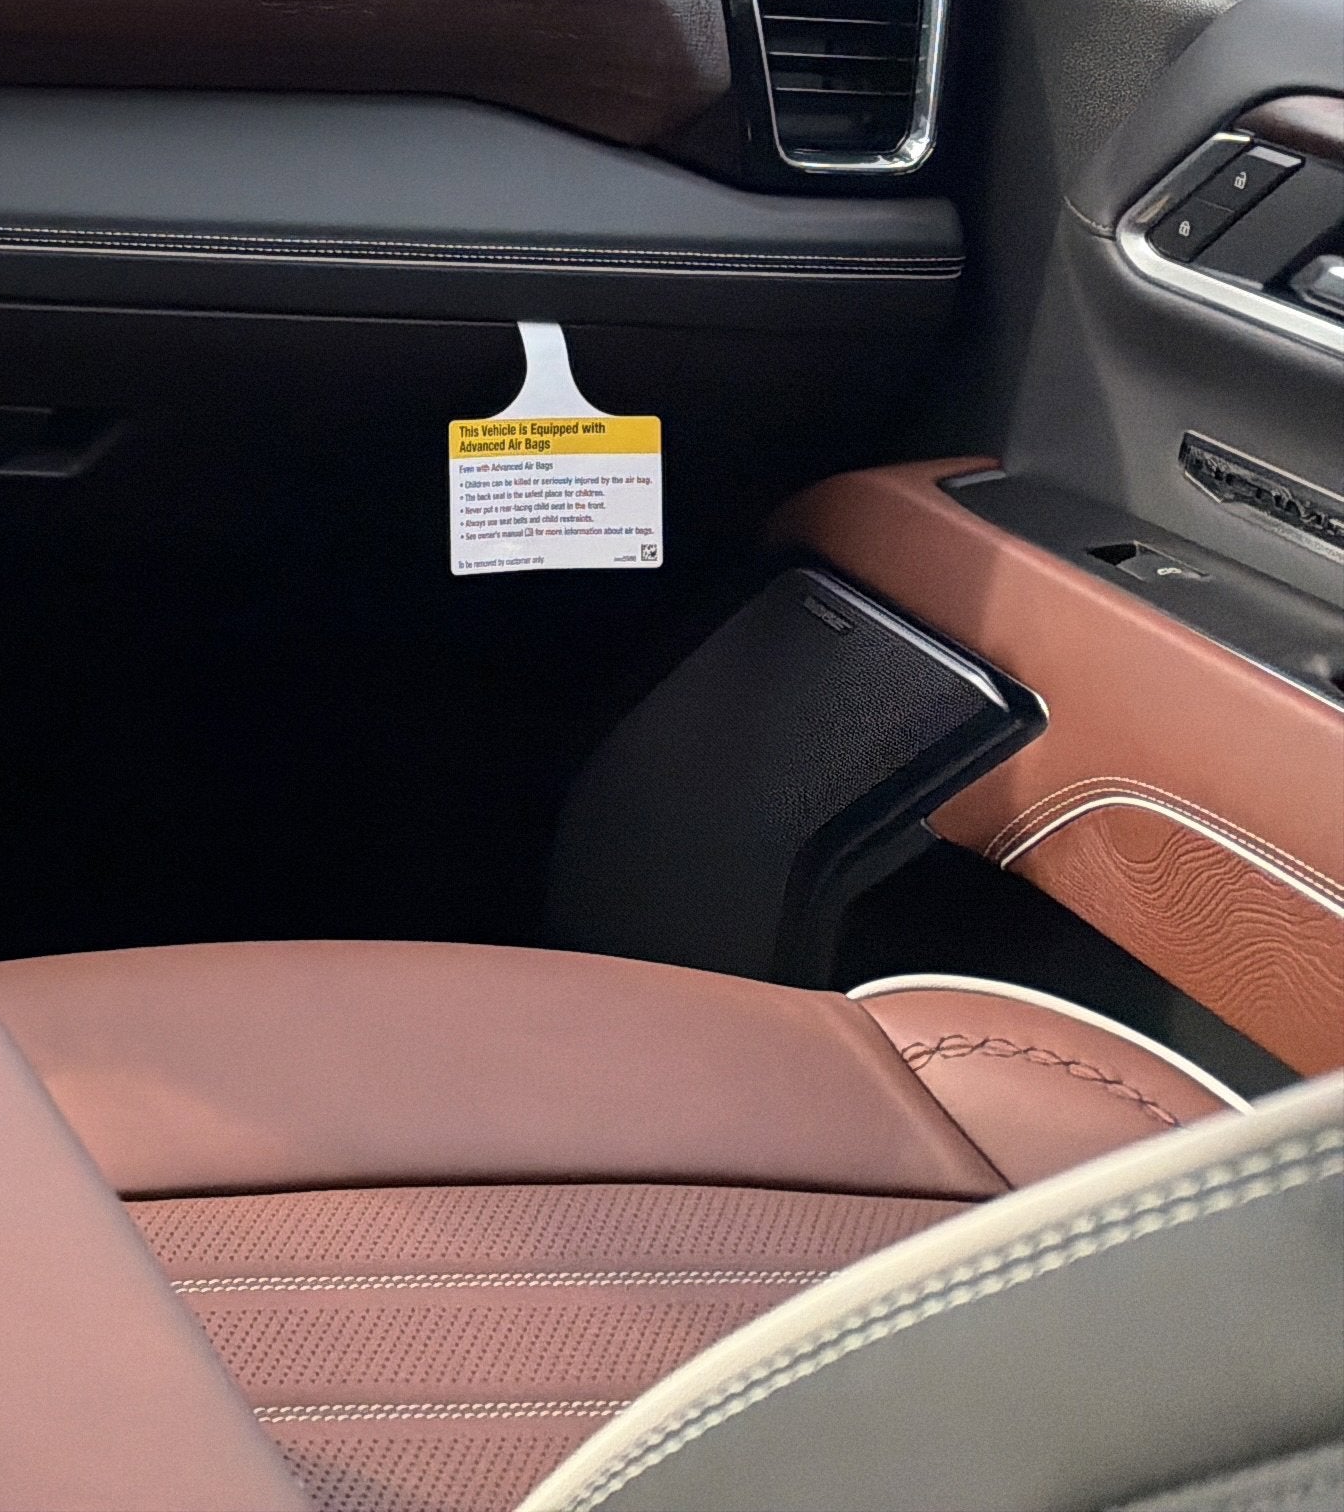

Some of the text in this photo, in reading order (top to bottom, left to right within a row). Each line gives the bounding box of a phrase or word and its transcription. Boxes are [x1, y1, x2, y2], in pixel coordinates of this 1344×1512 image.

[459, 422, 605, 438] This Vehicle is Equipped with
[459, 438, 551, 453] Advanced Air Bags
[459, 461, 553, 473] Even with Advanced Air Bags
[465, 481, 490, 489] Children
[514, 478, 531, 486] killed
[541, 477, 572, 485] seriously
[574, 476, 599, 486] injured
[601, 477, 609, 486] by
[636, 476, 652, 485] bag.
[477, 493, 491, 501] back
[545, 490, 562, 499] place
[565, 489, 573, 497] for
[575, 489, 604, 497] children.
[465, 507, 482, 515] Never
[483, 506, 493, 515] put
[499, 504, 532, 513] rear-facing
[465, 520, 485, 528] Always
[513, 516, 527, 524] belts
[542, 515, 558, 523] child
[560, 514, 594, 522] restraints.
[478, 531, 500, 539] owner's
[502, 529, 523, 537] manual
[564, 527, 602, 535] information
[604, 527, 623, 535] about
[635, 527, 654, 536] bags.
[465, 560, 472, 568] be
[474, 559, 496, 568] removed
[498, 559, 504, 567] by
